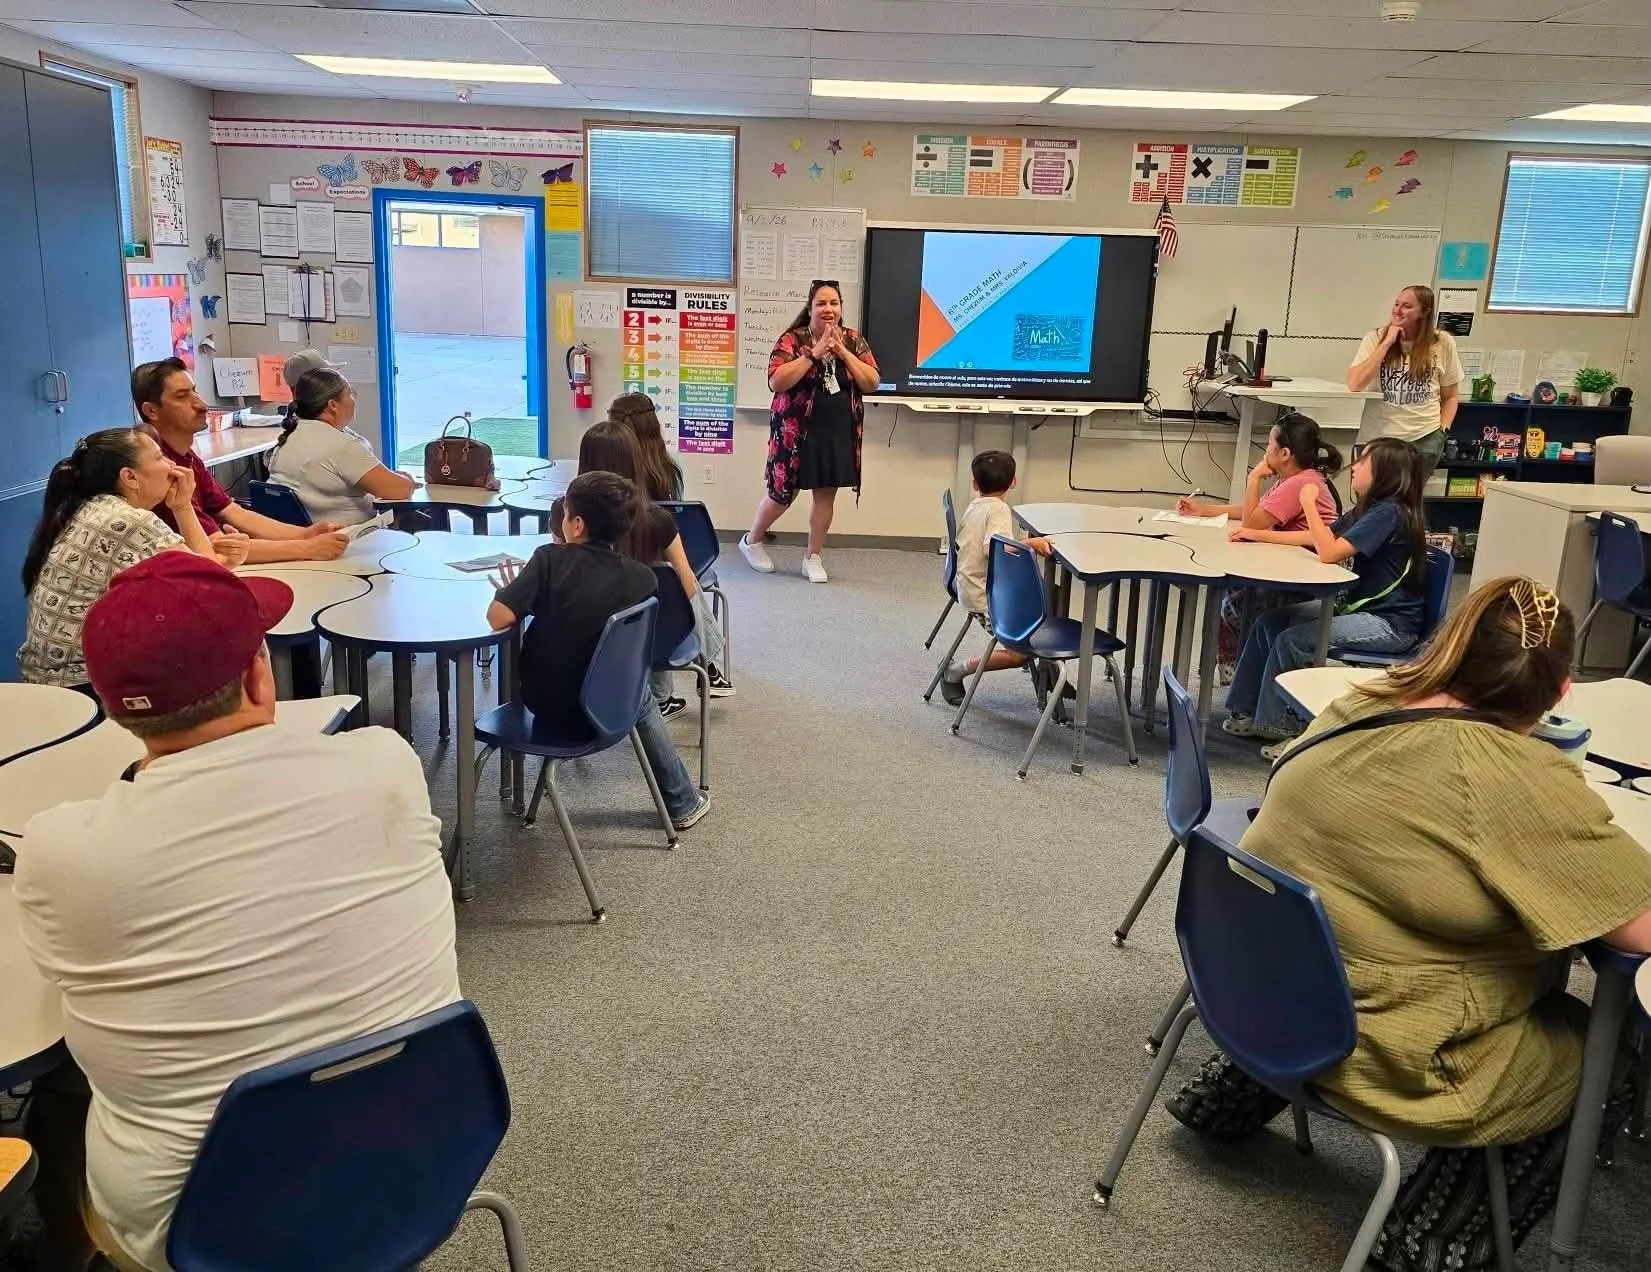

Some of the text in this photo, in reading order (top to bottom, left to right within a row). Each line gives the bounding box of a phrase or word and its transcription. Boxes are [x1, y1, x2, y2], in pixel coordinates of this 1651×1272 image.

[1004, 260, 1028, 281] VALDIVIA
[959, 285, 983, 307] GRADE
[982, 269, 1002, 288] MATH
[684, 292, 730, 300] DIVISIBILITY
[687, 300, 728, 310] RULES
[628, 312, 640, 327] 2
[628, 330, 640, 344] 3
[1030, 329, 1060, 345] Math
[628, 347, 640, 361] 4
[629, 365, 640, 378] 5
[628, 383, 640, 393] 6
